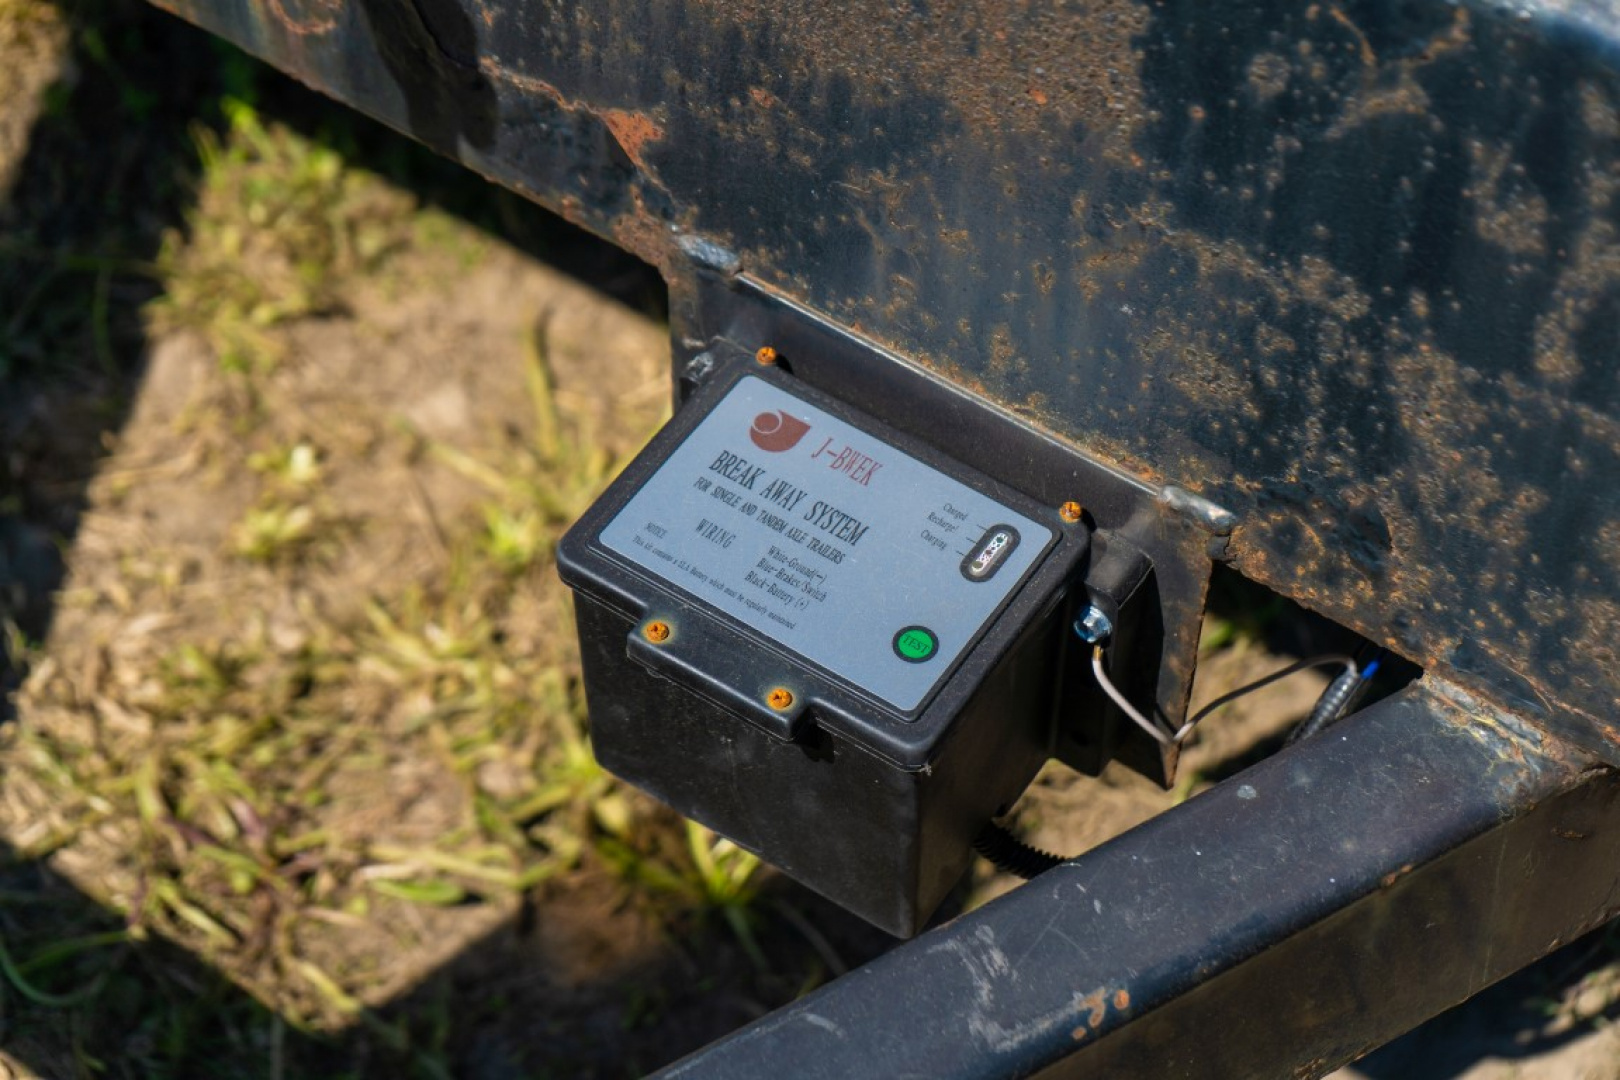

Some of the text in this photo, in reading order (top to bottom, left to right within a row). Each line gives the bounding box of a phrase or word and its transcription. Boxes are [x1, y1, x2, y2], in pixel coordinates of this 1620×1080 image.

[809, 436, 884, 486] J-BWEK
[708, 449, 871, 546] BREAK AWAY SYSTEM
[939, 502, 970, 522] Charged
[642, 521, 668, 539] NOTICE
[692, 476, 848, 565] FOR SINGLE AND TANDEM AXLE TRAILERS
[692, 518, 737, 549] WIRING
[916, 528, 950, 551] Charging
[631, 534, 646, 546] This
[650, 547, 674, 562] contains
[687, 566, 710, 583] Battery
[707, 576, 726, 590] which
[722, 586, 738, 598] must
[741, 597, 769, 616] regularly
[766, 609, 797, 629] maintained
[741, 570, 797, 606] Black-Battery
[902, 635, 930, 654] TEST
